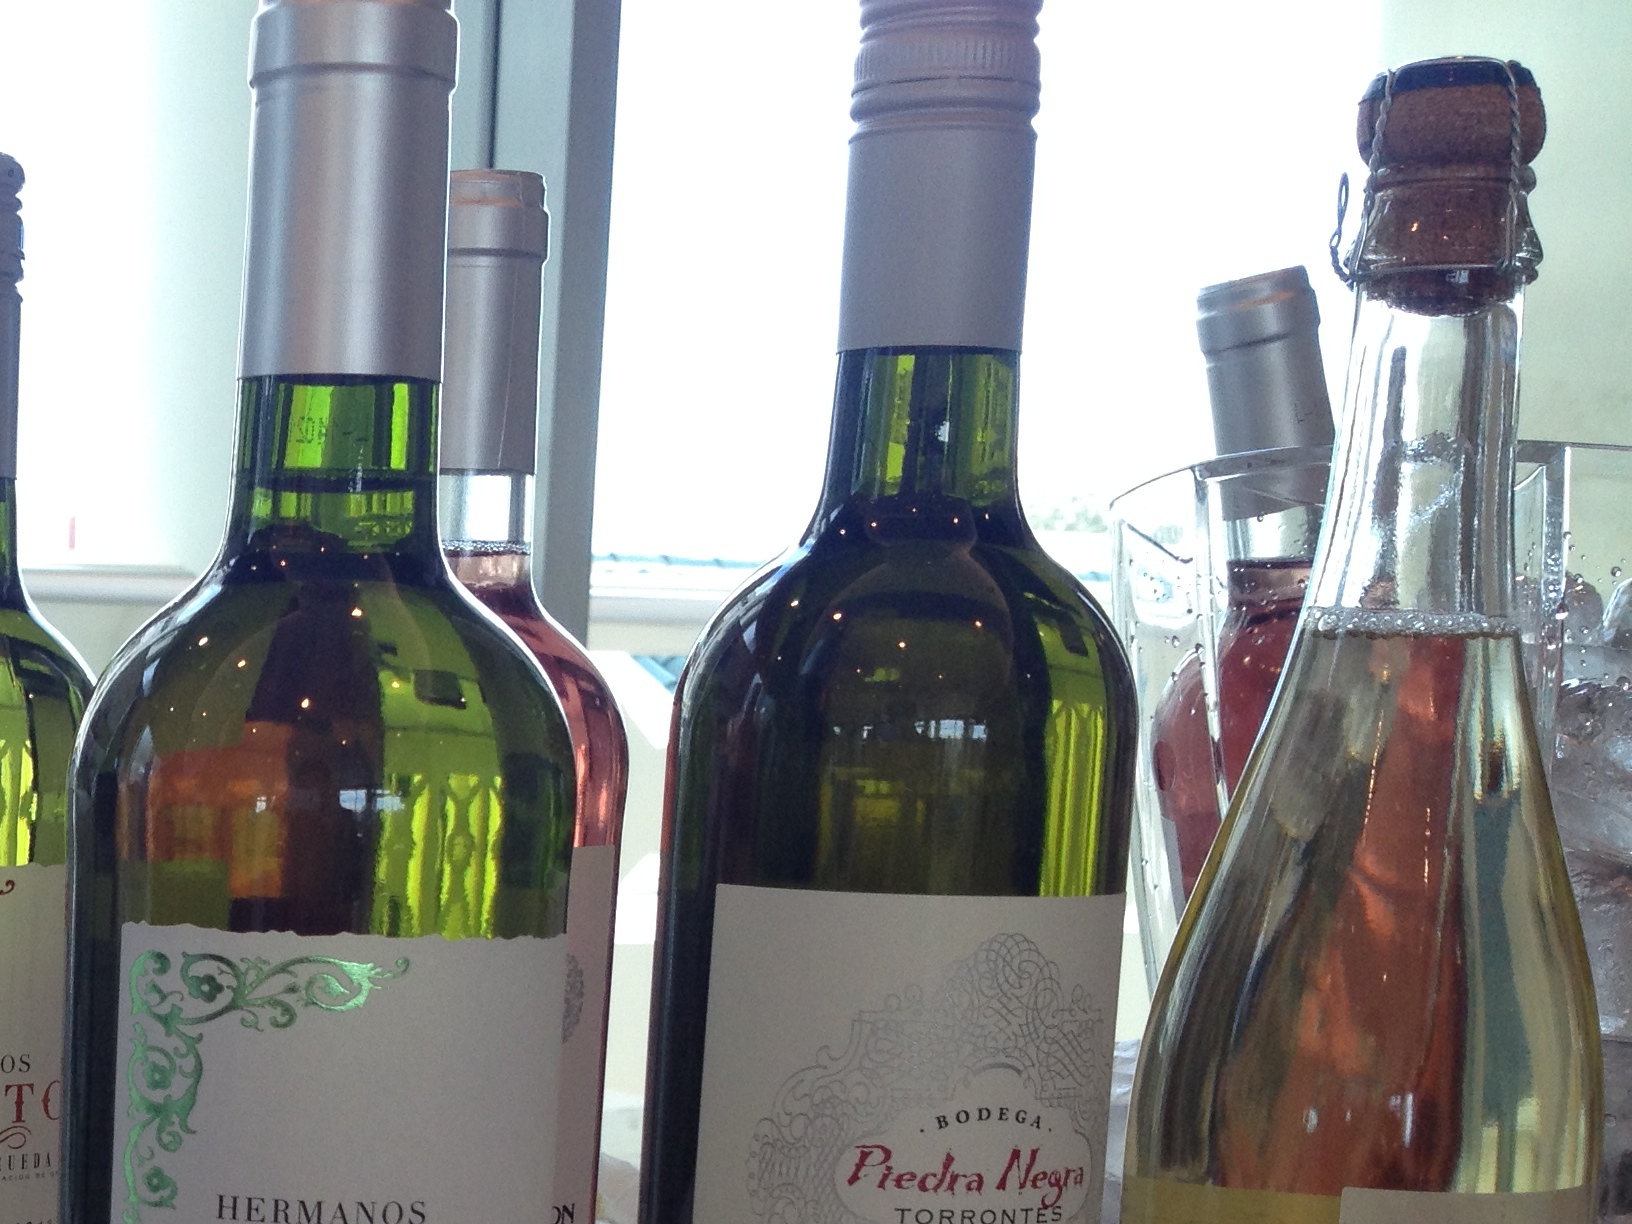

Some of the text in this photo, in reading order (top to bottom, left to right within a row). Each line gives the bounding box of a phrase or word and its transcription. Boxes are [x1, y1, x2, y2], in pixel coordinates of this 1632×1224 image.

[935, 1107, 1044, 1130] BODEGA
[847, 1144, 1085, 1210] Piedra Negra
